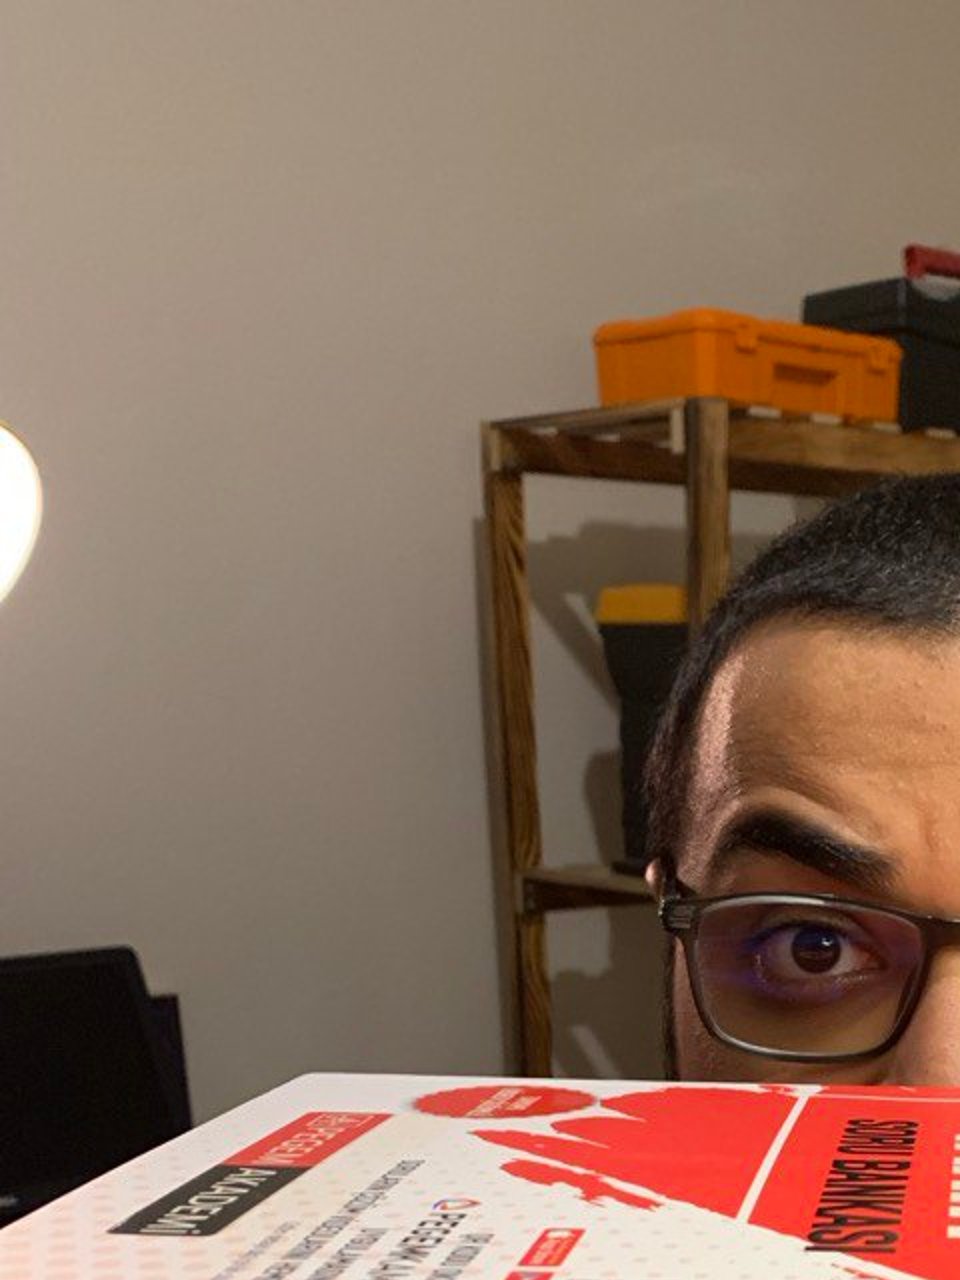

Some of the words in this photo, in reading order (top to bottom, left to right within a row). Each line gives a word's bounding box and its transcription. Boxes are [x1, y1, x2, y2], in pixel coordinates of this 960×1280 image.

[250, 1126, 345, 1166] PEGEM
[836, 1118, 919, 1157] SORU
[139, 1167, 277, 1235] AKADEMİ
[804, 1158, 912, 1254] BANKASI
